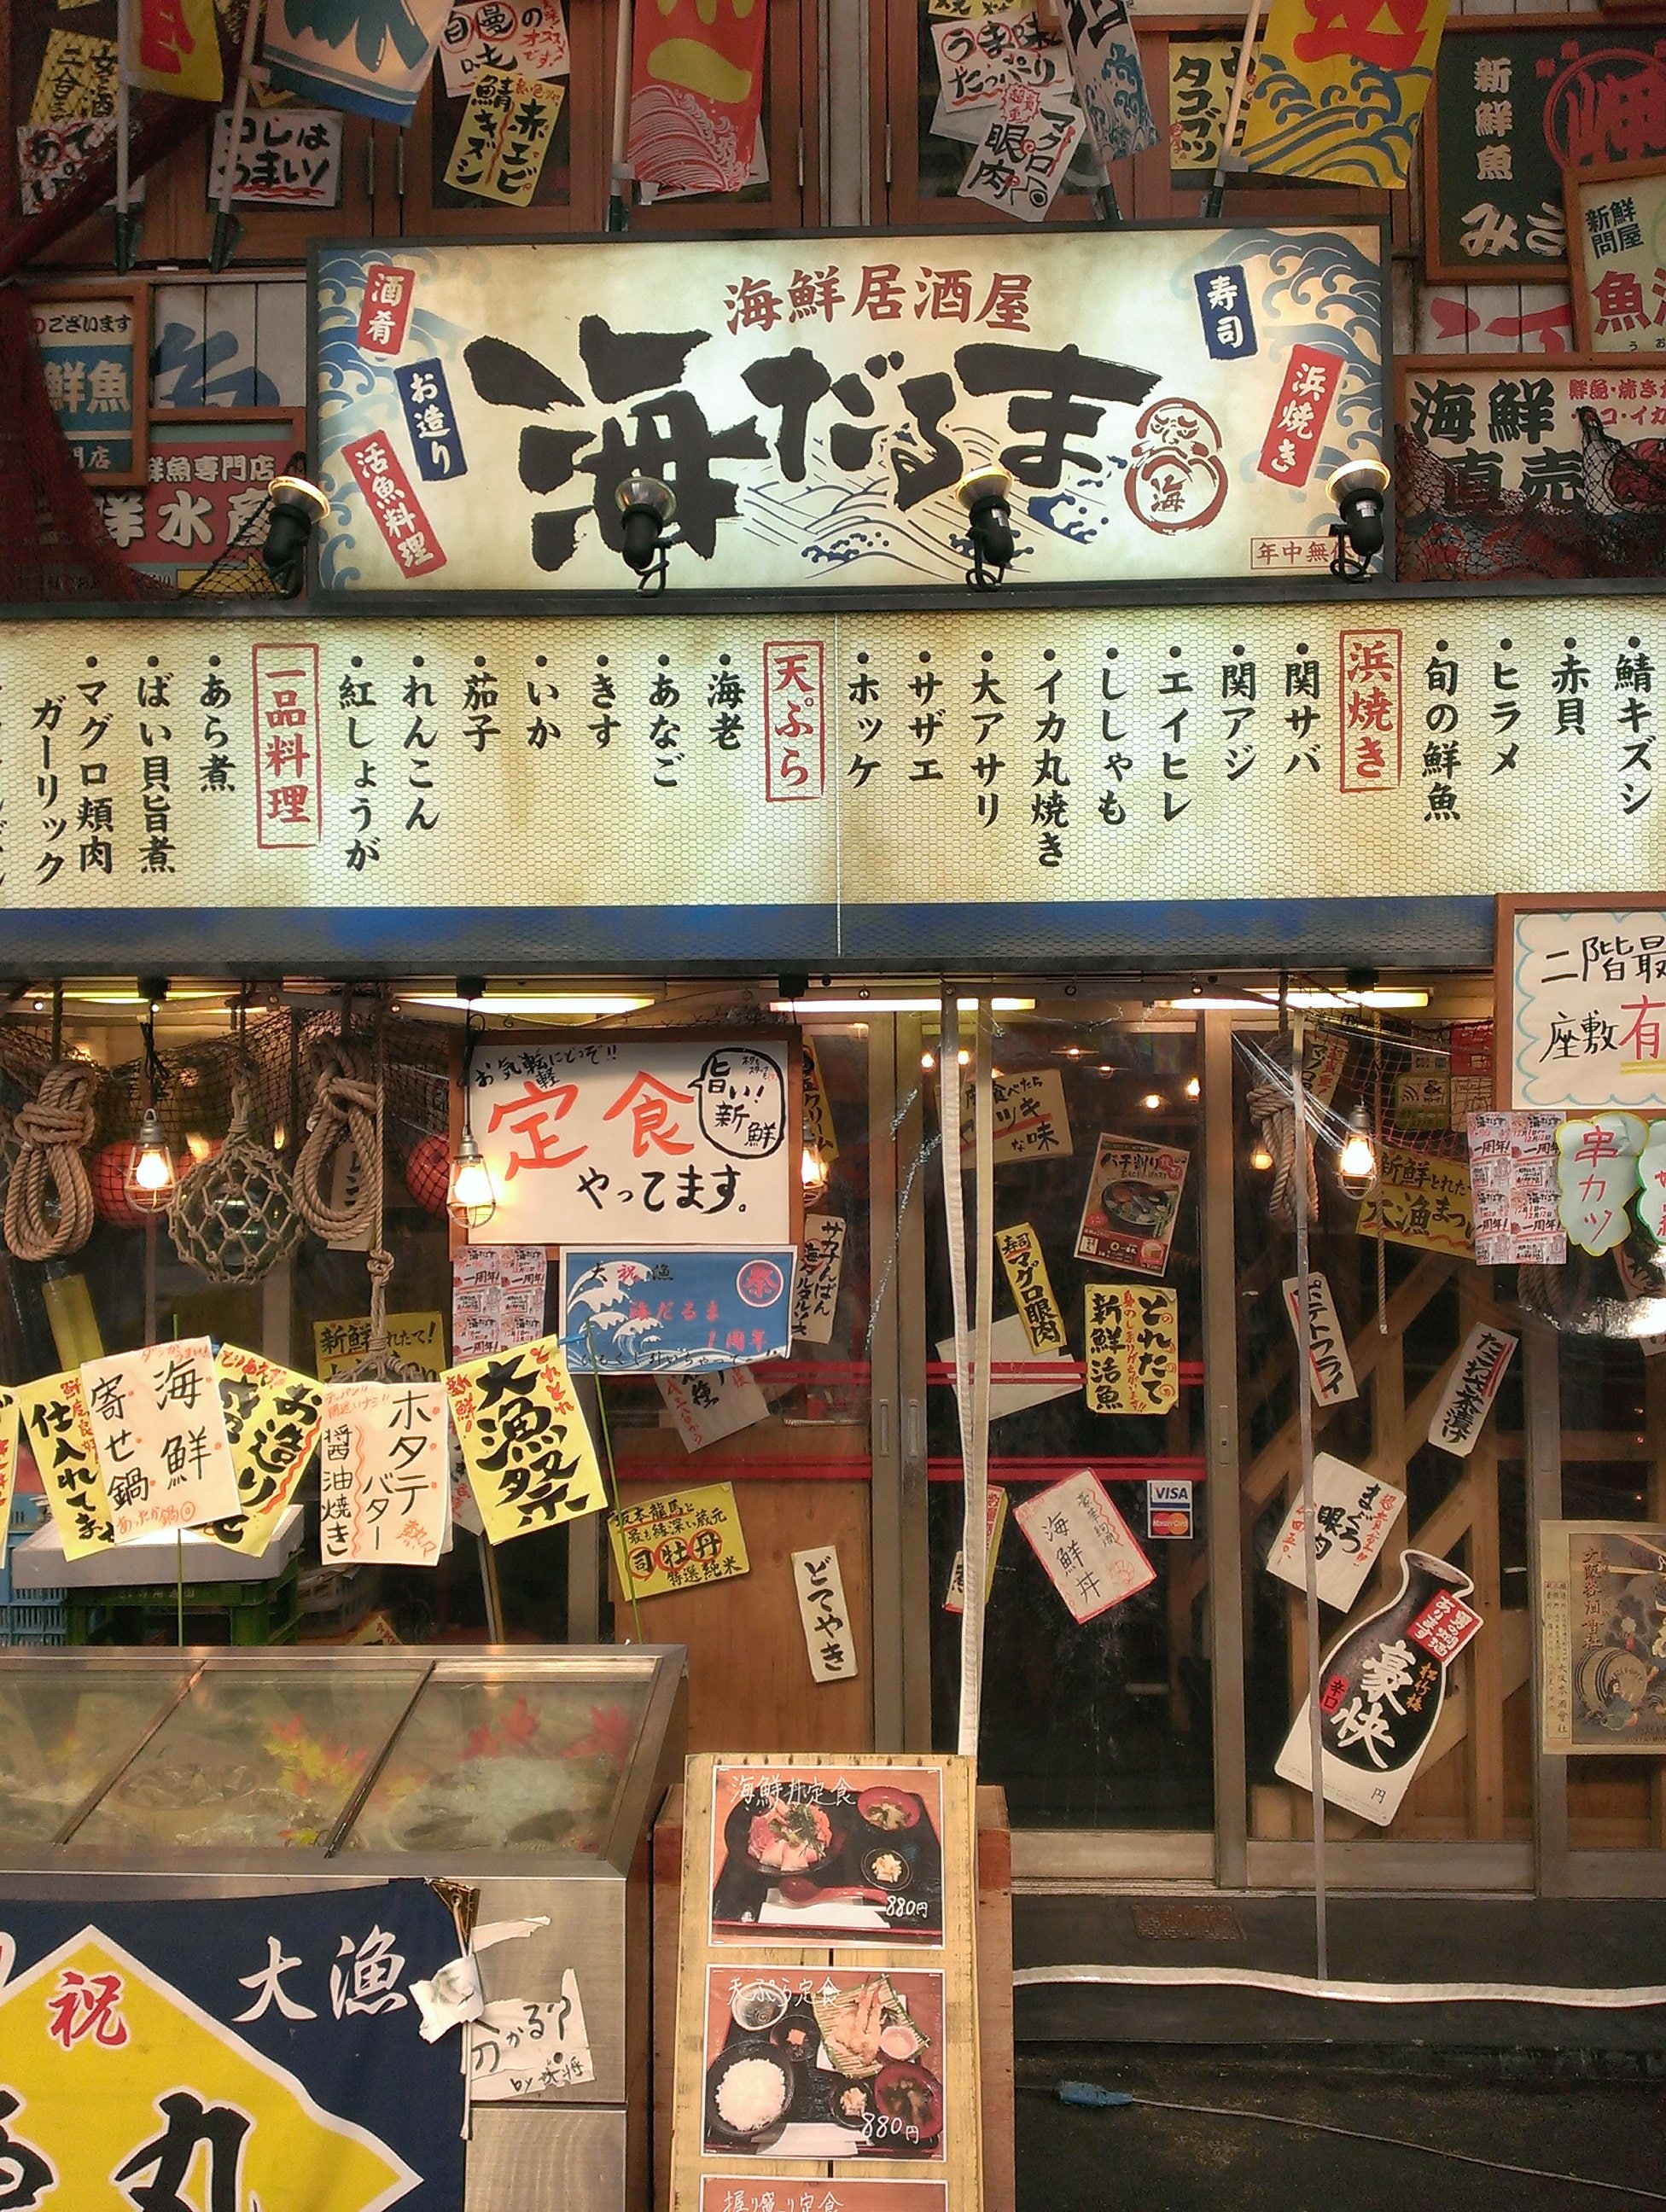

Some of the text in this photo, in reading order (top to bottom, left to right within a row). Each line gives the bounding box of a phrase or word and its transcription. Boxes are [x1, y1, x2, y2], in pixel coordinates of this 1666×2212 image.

[496, 99, 546, 195] 赤エビ
[1474, 56, 1513, 181] 新鮮魚
[1584, 196, 1636, 233] 新鮮
[1590, 222, 1645, 259] 問屋
[365, 271, 405, 347] 酒肴
[723, 264, 1034, 334] 海鮮居酒屋
[1208, 275, 1246, 350] 寿司
[1591, 267, 1666, 335] 魚
[44, 359, 130, 414] 鮮魚
[409, 370, 453, 475] お造り
[1270, 363, 1328, 474] 浜焼き
[1410, 377, 1555, 445] 海鮮
[1569, 378, 1666, 400] 鮮魚・焼き
[463, 314, 1163, 573] 海だるま
[1150, 474, 1186, 514] 海
[355, 440, 436, 569] 活魚料理
[198, 672, 236, 793] あら煮
[462, 672, 501, 752] 茄子
[527, 680, 561, 748] いか
[587, 672, 621, 749] きす
[649, 672, 685, 788] あなご
[707, 670, 747, 751] 海老
[773, 654, 816, 787] 天ぷら
[847, 672, 884, 789] ホッケ
[907, 671, 947, 782] サザエ
[1221, 661, 1258, 782] 関アジ
[1283, 659, 1321, 774] 関サバ
[1347, 639, 1395, 779] 浜焼き
[1422, 656, 1462, 822] 旬の鮮魚
[1488, 662, 1523, 775] ヒラメ
[1551, 653, 1592, 736] 赤貝
[1614, 653, 1657, 815] 鯖キズシ
[31, 695, 67, 887] ガーリック
[137, 672, 177, 874] ばい貝旨煮
[265, 668, 312, 824] 一品料理
[339, 673, 382, 872] 紅しょうが
[402, 674, 440, 831] れんこん
[969, 668, 1007, 829] 大アサリ
[1031, 668, 1071, 868] イカ丸焼き
[1098, 667, 1133, 825] ししゃも
[1157, 671, 1194, 822] エイヒレ
[486, 1069, 696, 1182] 定食
[707, 1057, 766, 1103] 旨い!
[714, 1103, 778, 1149] 新鮮
[576, 1162, 748, 1214] やってます。
[1379, 1152, 1473, 1197] 新鮮とれた
[1575, 1124, 1619, 1243] 串カツ
[743, 1263, 779, 1299] 祭
[1009, 1253, 1061, 1348] マグロ眼肉
[319, 1321, 436, 1354] 新鮮れたて!
[1090, 1292, 1125, 1411] 新鮮活魚
[1137, 1295, 1172, 1406] とれたて
[90, 1374, 150, 1511] 寄せ鍋
[153, 1357, 212, 1491] 海鮮
[237, 1382, 324, 1508] お造り
[388, 1390, 433, 1516] ホタテ
[475, 1353, 591, 1528] 大漁祭
[321, 1423, 353, 1557] 醤油焼き
[362, 1473, 393, 1551] バター
[1155, 1487, 1190, 1500] VISA
[632, 1532, 722, 1575] 司牡丹
[667, 1555, 743, 1587] 特選純米
[1041, 1511, 1101, 1604] 海鮮丼
[803, 1555, 845, 1673] どてやき
[1323, 1678, 1346, 1712] 辛口
[1331, 1639, 1419, 1770] 豪快
[730, 1773, 859, 1809] 海鮮丼定食
[1371, 1787, 1387, 1804] 円
[885, 1895, 929, 1918] 880円
[49, 1970, 128, 2048] 祝
[232, 1924, 411, 2023] 大漁
[727, 1976, 843, 2008] 天ぷら定食
[510, 2077, 534, 2093] by
[860, 2111, 920, 2144] 880円
